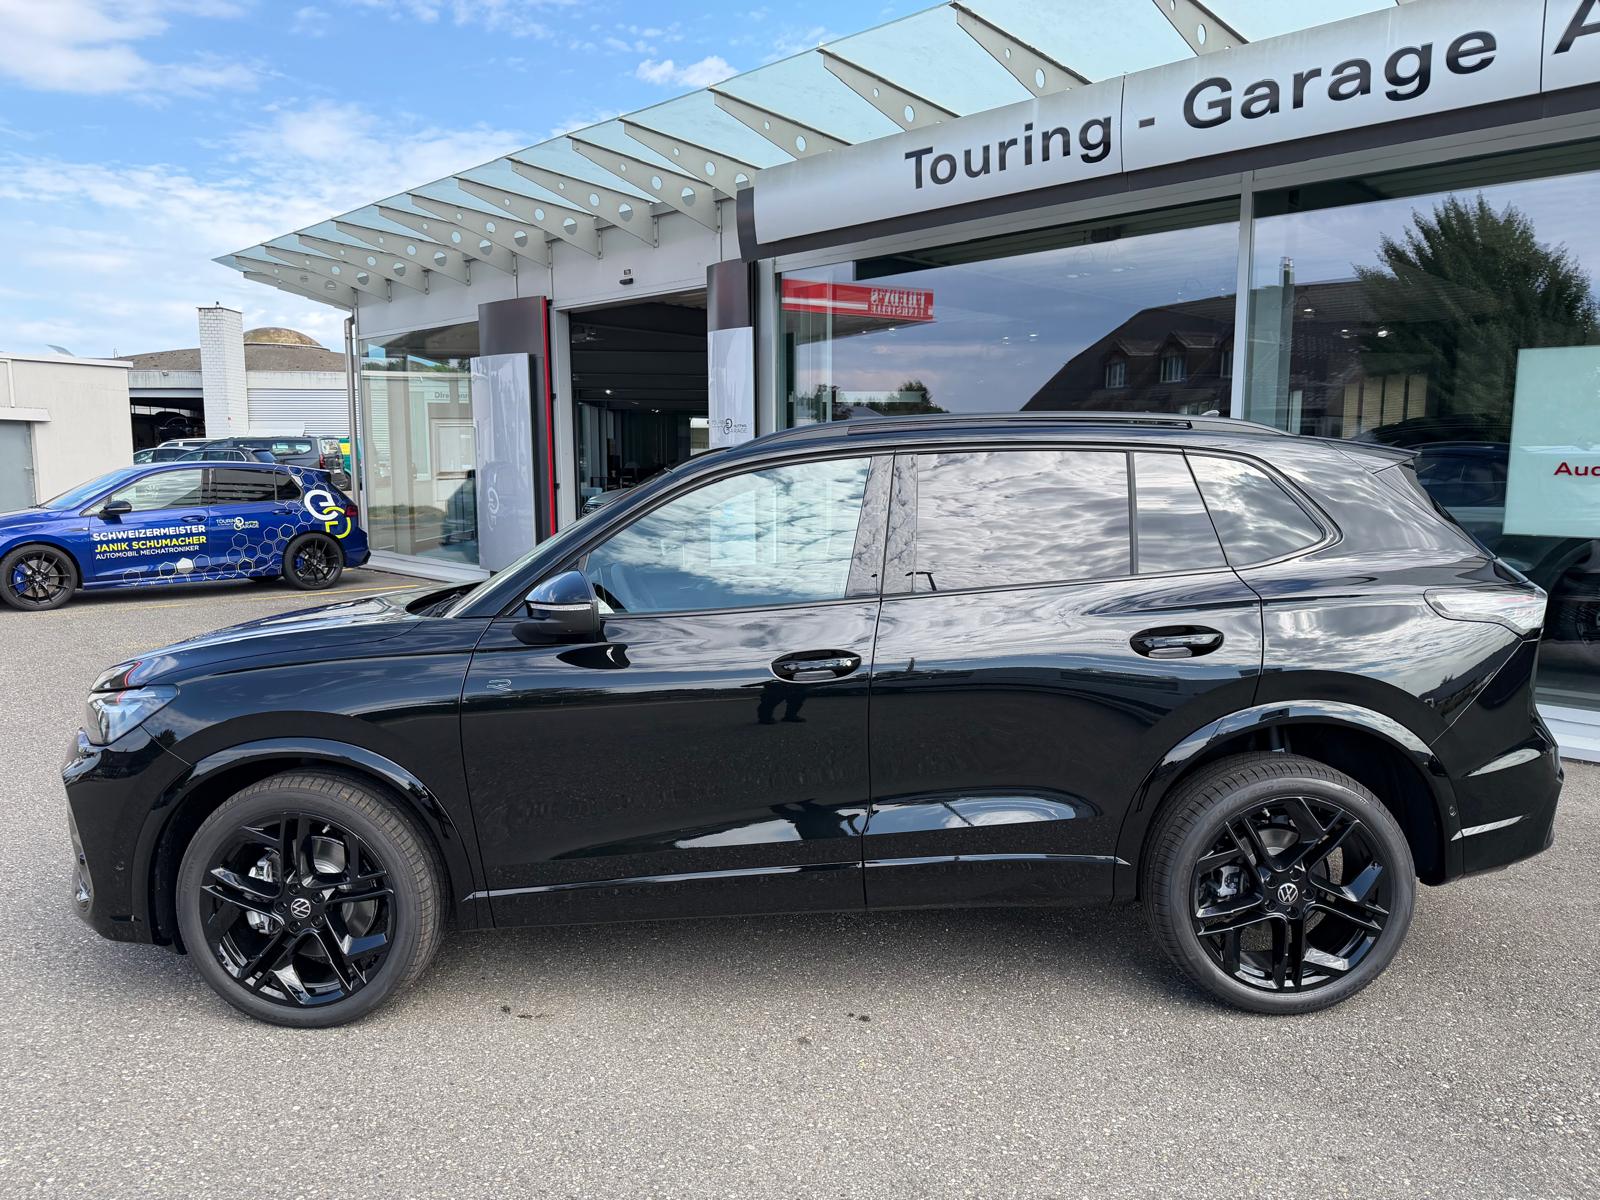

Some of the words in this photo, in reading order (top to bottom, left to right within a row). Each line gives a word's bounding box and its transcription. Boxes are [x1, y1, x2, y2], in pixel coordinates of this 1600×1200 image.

[904, 115, 1112, 189] Touring
[1139, 117, 1155, 128] -
[1183, 30, 1497, 129] Garage
[93, 525, 206, 541] SCHWEIZERMEISTER
[95, 542, 129, 552] JANIK
[132, 535, 207, 549] SCHUMACHER
[96, 550, 139, 560] AUTOMOBIL
[140, 545, 200, 556] MECHATRONIKER
